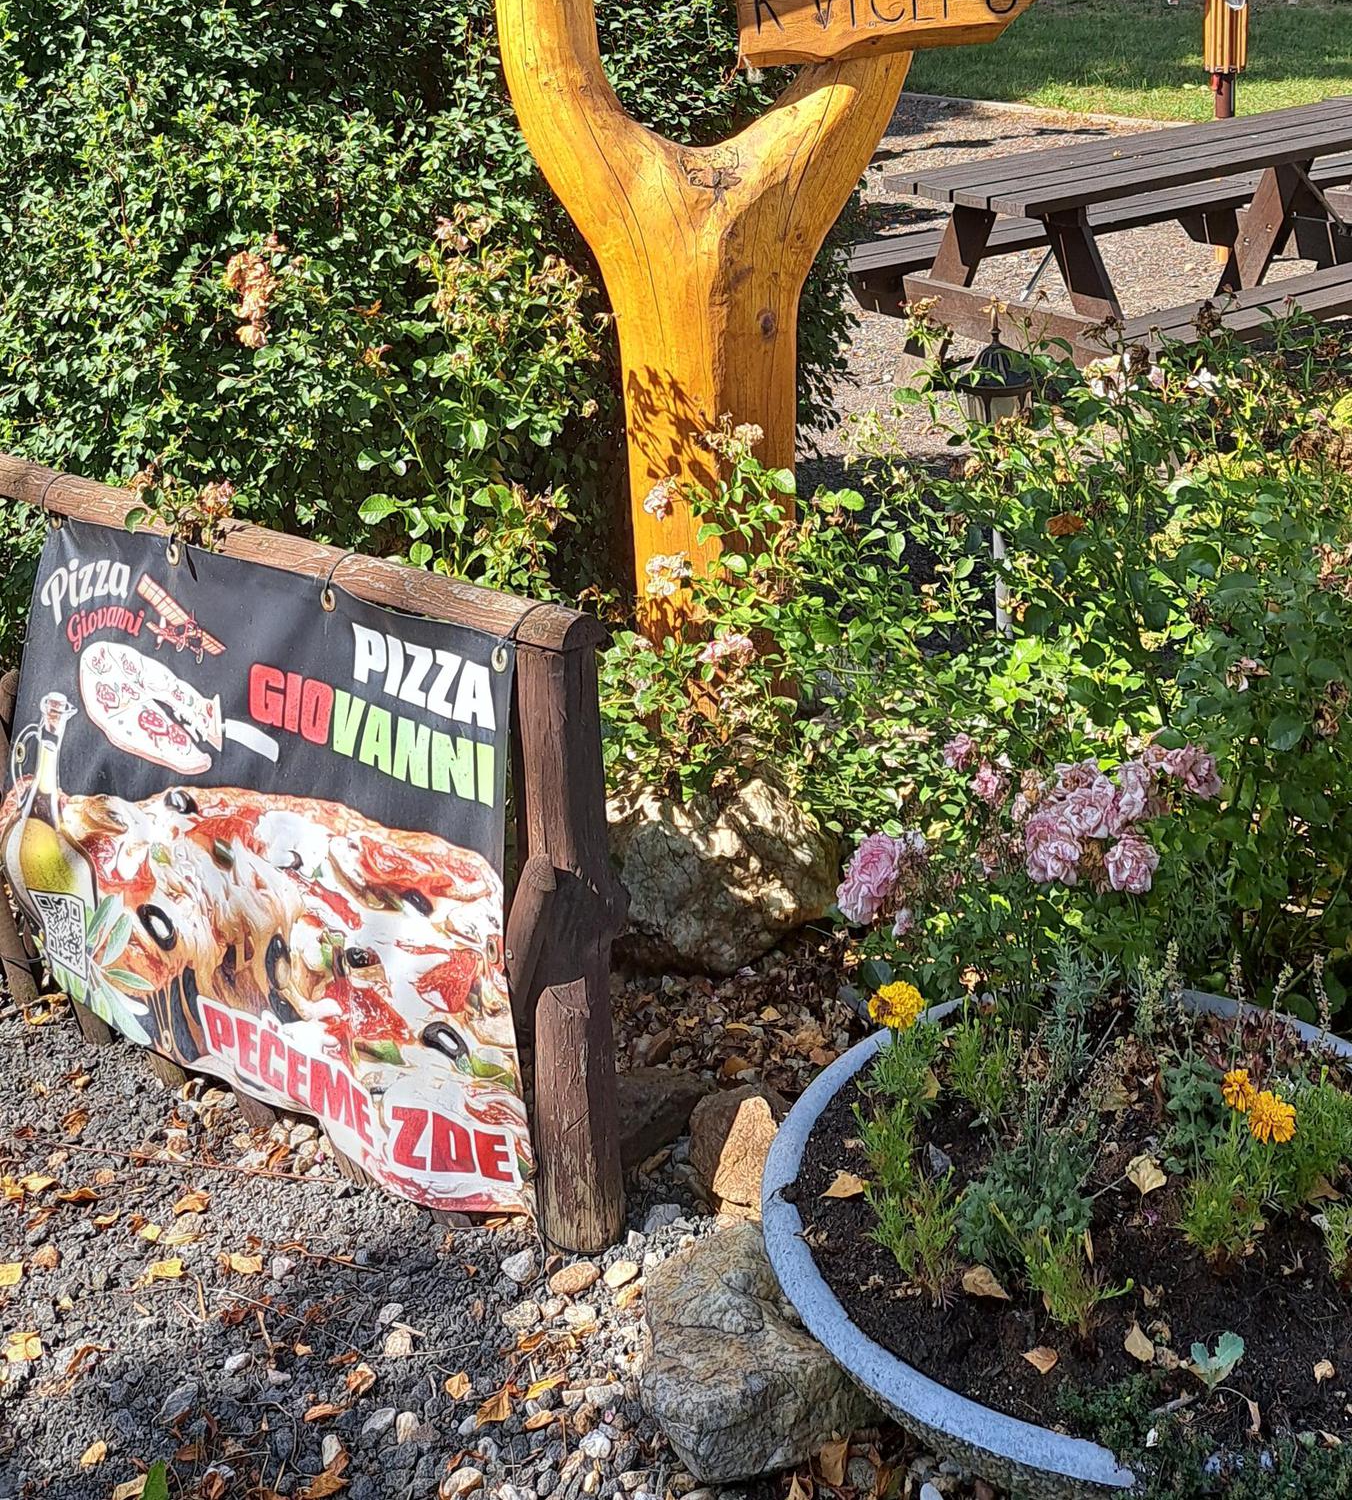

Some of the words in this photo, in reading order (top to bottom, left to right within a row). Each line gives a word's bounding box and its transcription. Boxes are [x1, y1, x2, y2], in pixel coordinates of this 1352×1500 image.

[40, 558, 131, 626] Pizza
[66, 605, 145, 653] Giovanni
[352, 621, 497, 731] PIZZA
[248, 663, 495, 808] GIOVANNI
[202, 1001, 375, 1148] PEČEME
[391, 1105, 515, 1183] ZDE
